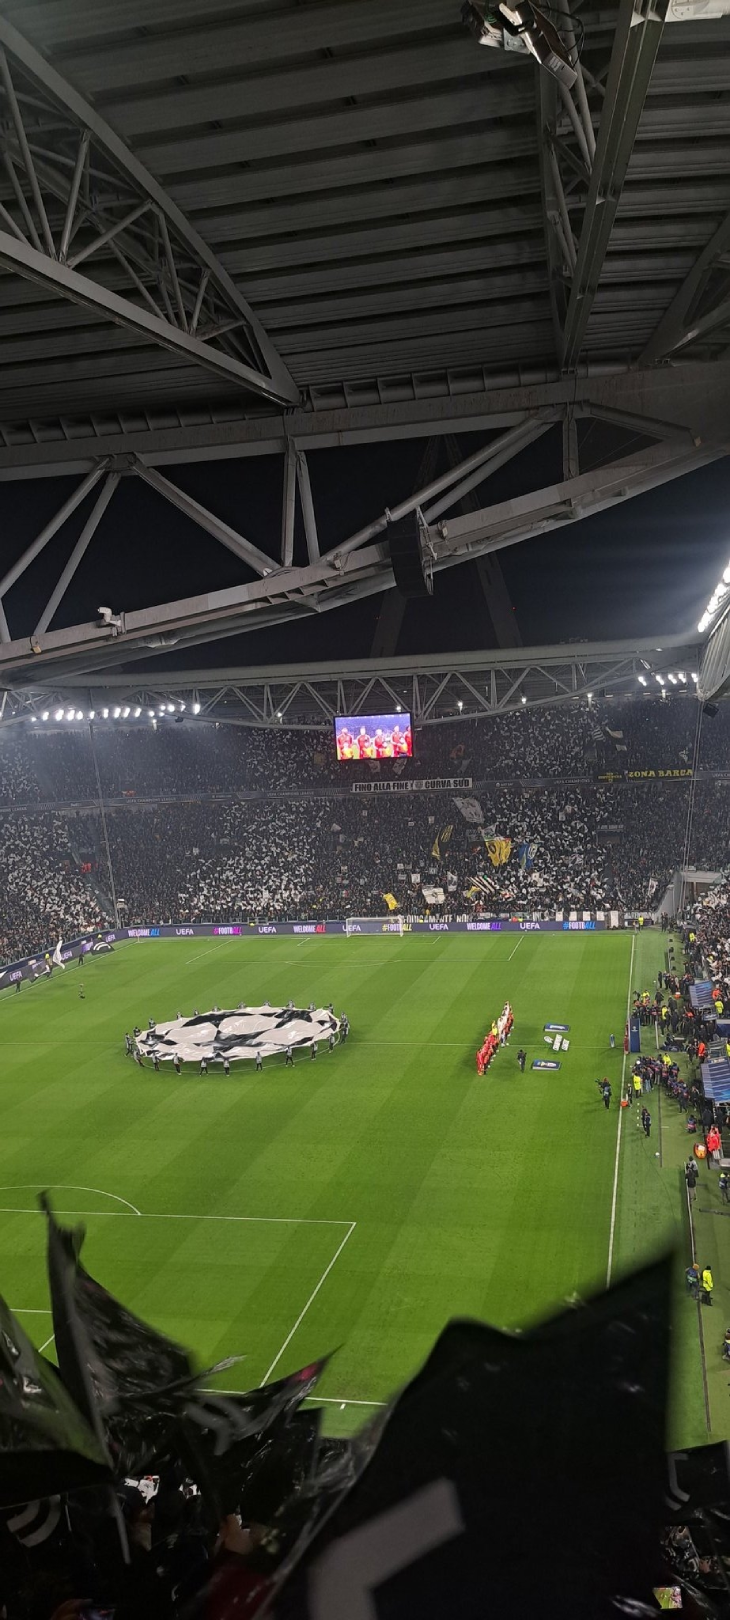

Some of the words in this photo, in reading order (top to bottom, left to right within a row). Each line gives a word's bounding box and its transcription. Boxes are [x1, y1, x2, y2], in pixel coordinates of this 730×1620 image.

[628, 770, 656, 778] ZONA
[354, 783, 372, 792] FINO
[373, 783, 391, 791] ALLA
[392, 781, 409, 790] FINE
[425, 780, 451, 789] CURVA
[454, 778, 470, 788] SUD
[258, 926, 277, 934] UEFA
[293, 925, 316, 933] WELCOME
[316, 924, 326, 933] ALL
[342, 924, 362, 932] UEFA
[429, 923, 449, 931] UEFA
[466, 922, 490, 931] WELCOME
[491, 921, 501, 930] ALL
[520, 921, 540, 930] UEFA
[563, 921, 596, 930] #FOOTBALL
[128, 928, 150, 937] WELCOME
[150, 928, 160, 936] ALL
[176, 928, 194, 936] UEFA
